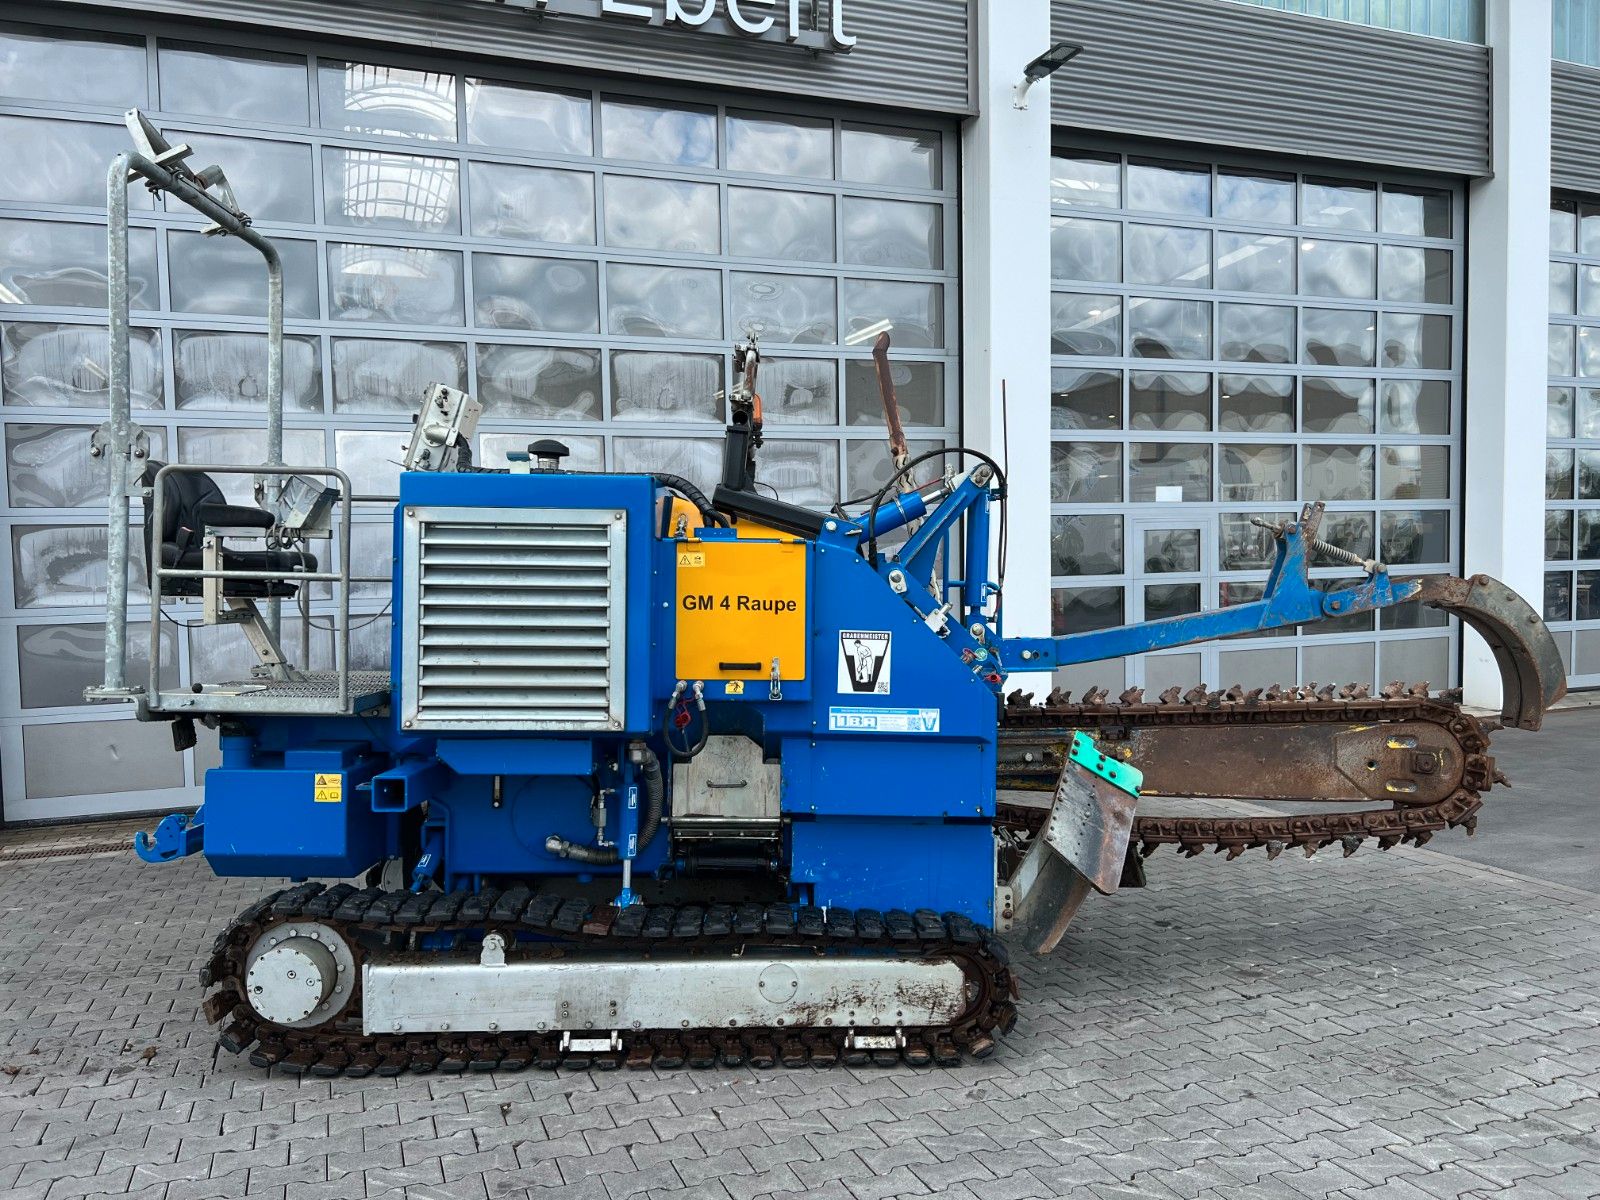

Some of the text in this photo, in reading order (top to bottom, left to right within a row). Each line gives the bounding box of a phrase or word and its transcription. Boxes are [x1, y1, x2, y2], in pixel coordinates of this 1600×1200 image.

[601, 0, 857, 46] ert
[682, 595, 797, 615] GM 4 Raupe
